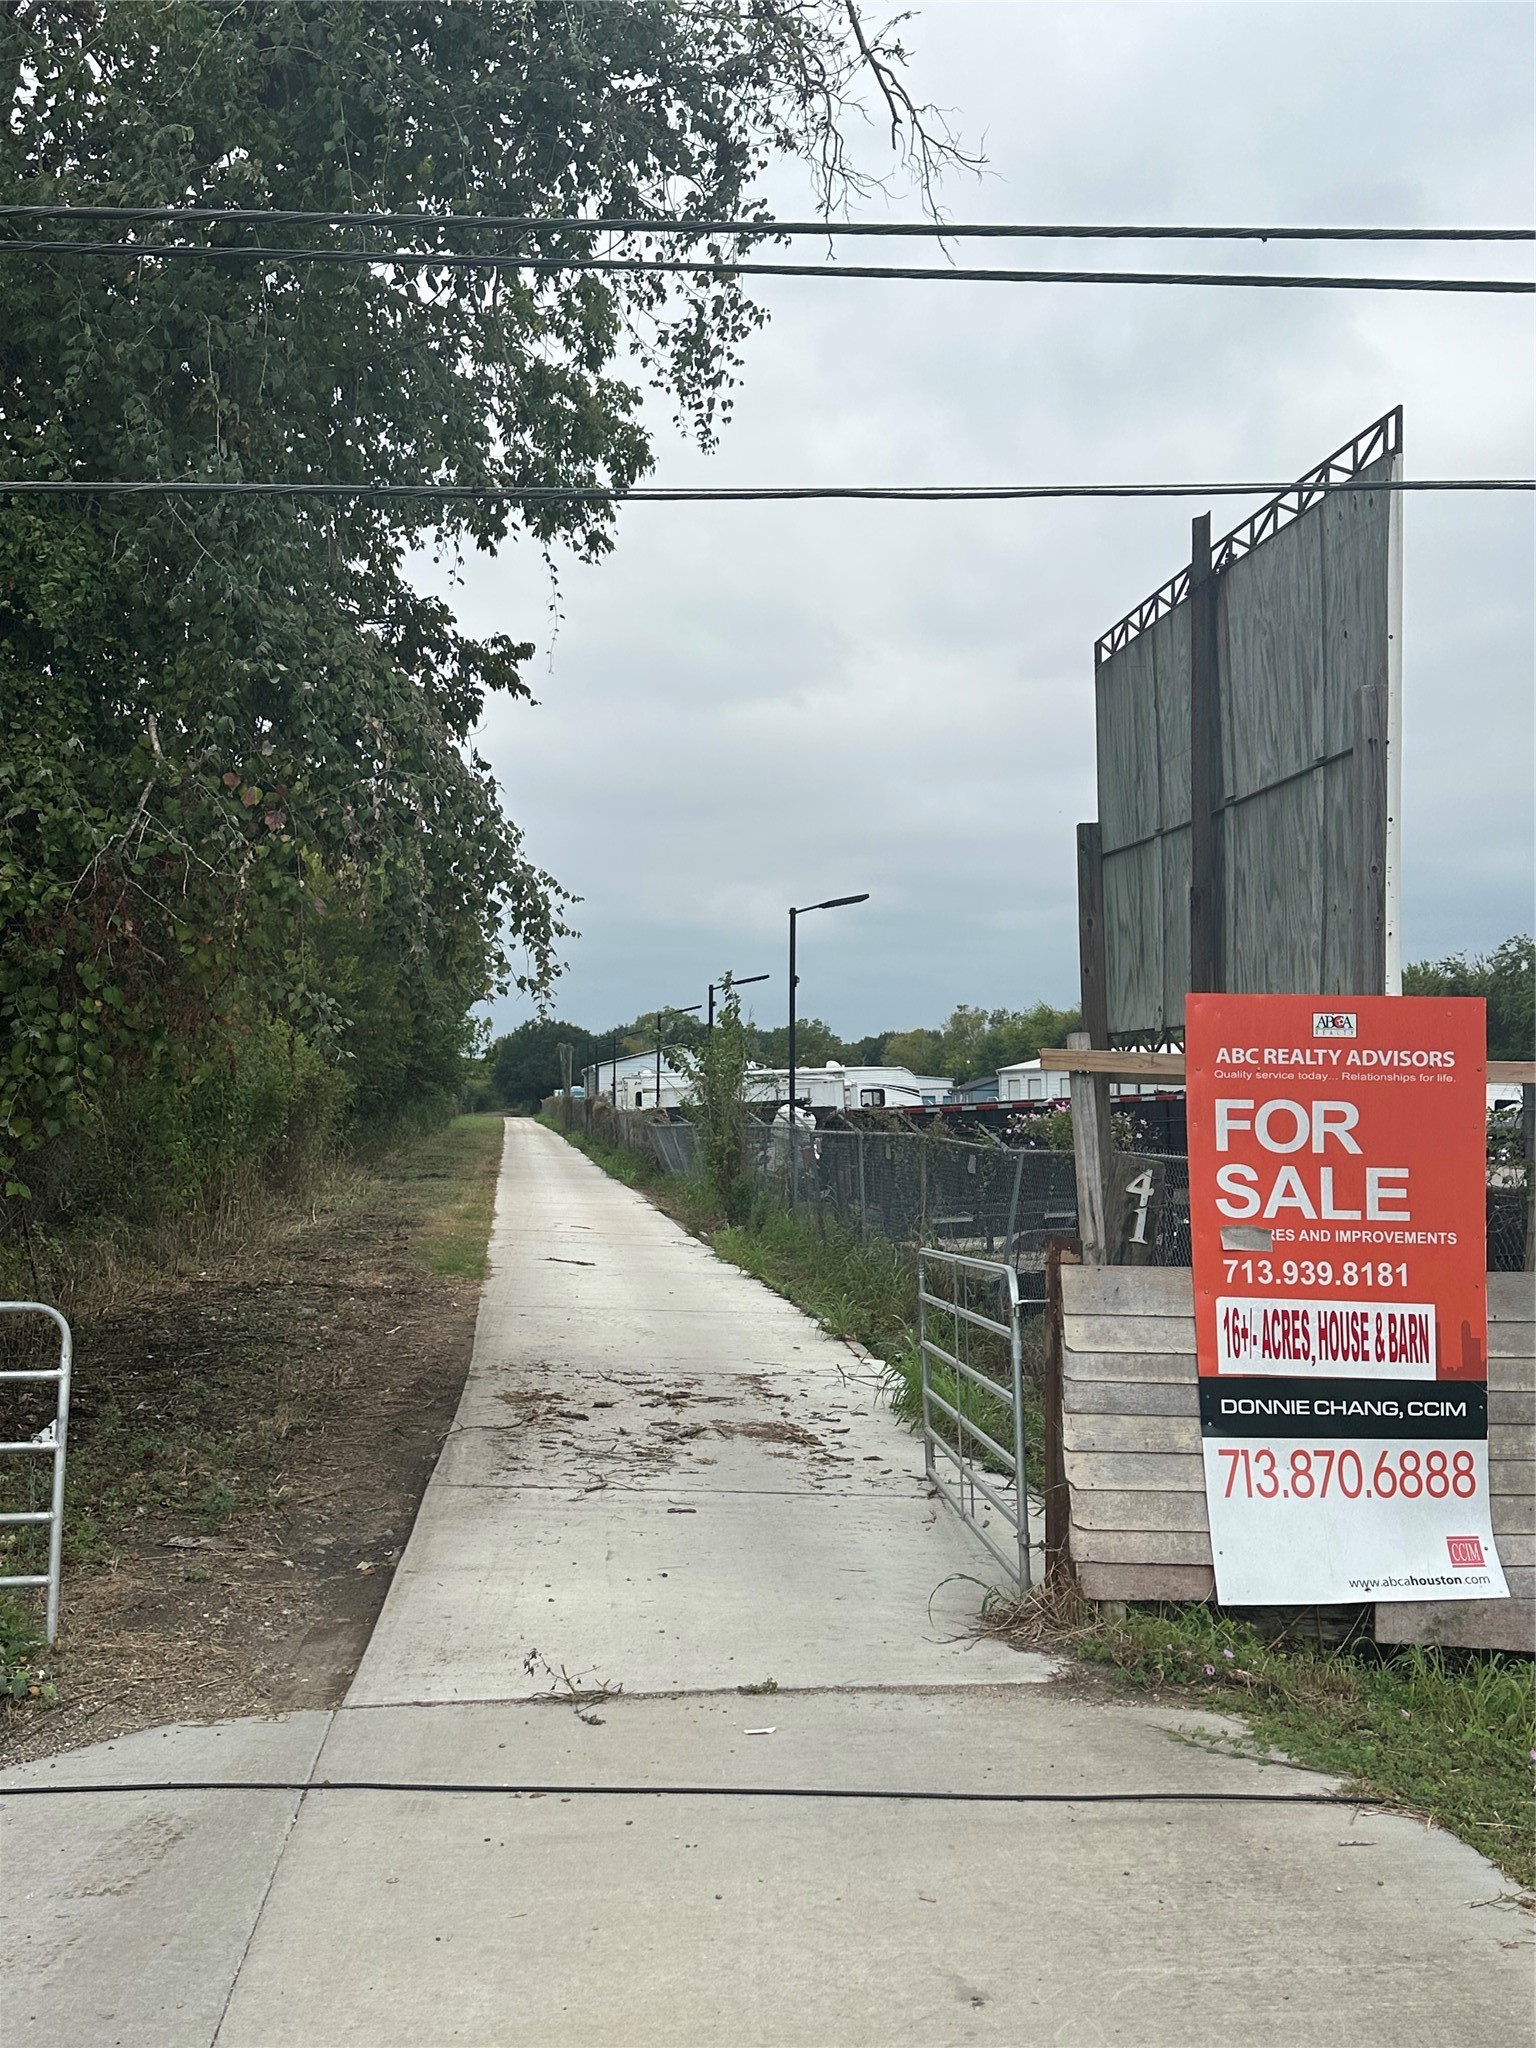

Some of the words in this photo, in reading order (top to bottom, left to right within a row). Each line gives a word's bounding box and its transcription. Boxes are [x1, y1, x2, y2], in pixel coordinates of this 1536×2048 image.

[1215, 1047, 1259, 1065] ABC
[1263, 1049, 1342, 1066] REALTY
[1346, 1050, 1456, 1068] ADVISORS
[1214, 1069, 1253, 1080] Quality
[1255, 1069, 1295, 1080] service
[1297, 1071, 1339, 1083] today...
[1341, 1072, 1417, 1083] Relationships
[1418, 1073, 1435, 1083] for
[1437, 1073, 1457, 1083] life.
[1215, 1098, 1364, 1155] FOR
[1215, 1163, 1411, 1222] SALE
[1298, 1230, 1332, 1243] AND
[1334, 1231, 1458, 1245] IMPROVEMENTS
[1222, 1259, 1409, 1288] 713.939.8181
[1261, 1308, 1317, 1367] ACRES,
[1318, 1310, 1371, 1363] HOUSE
[1375, 1312, 1386, 1364] &
[1388, 1313, 1431, 1365] BARN
[1220, 1398, 1311, 1416] DONNIE
[1313, 1399, 1405, 1419] CHANG,
[1407, 1400, 1468, 1418] CCIM
[1217, 1448, 1477, 1500] 713.870.6888
[1451, 1543, 1481, 1561] CCIM
[1348, 1575, 1491, 1589] www.abcahouston.com
